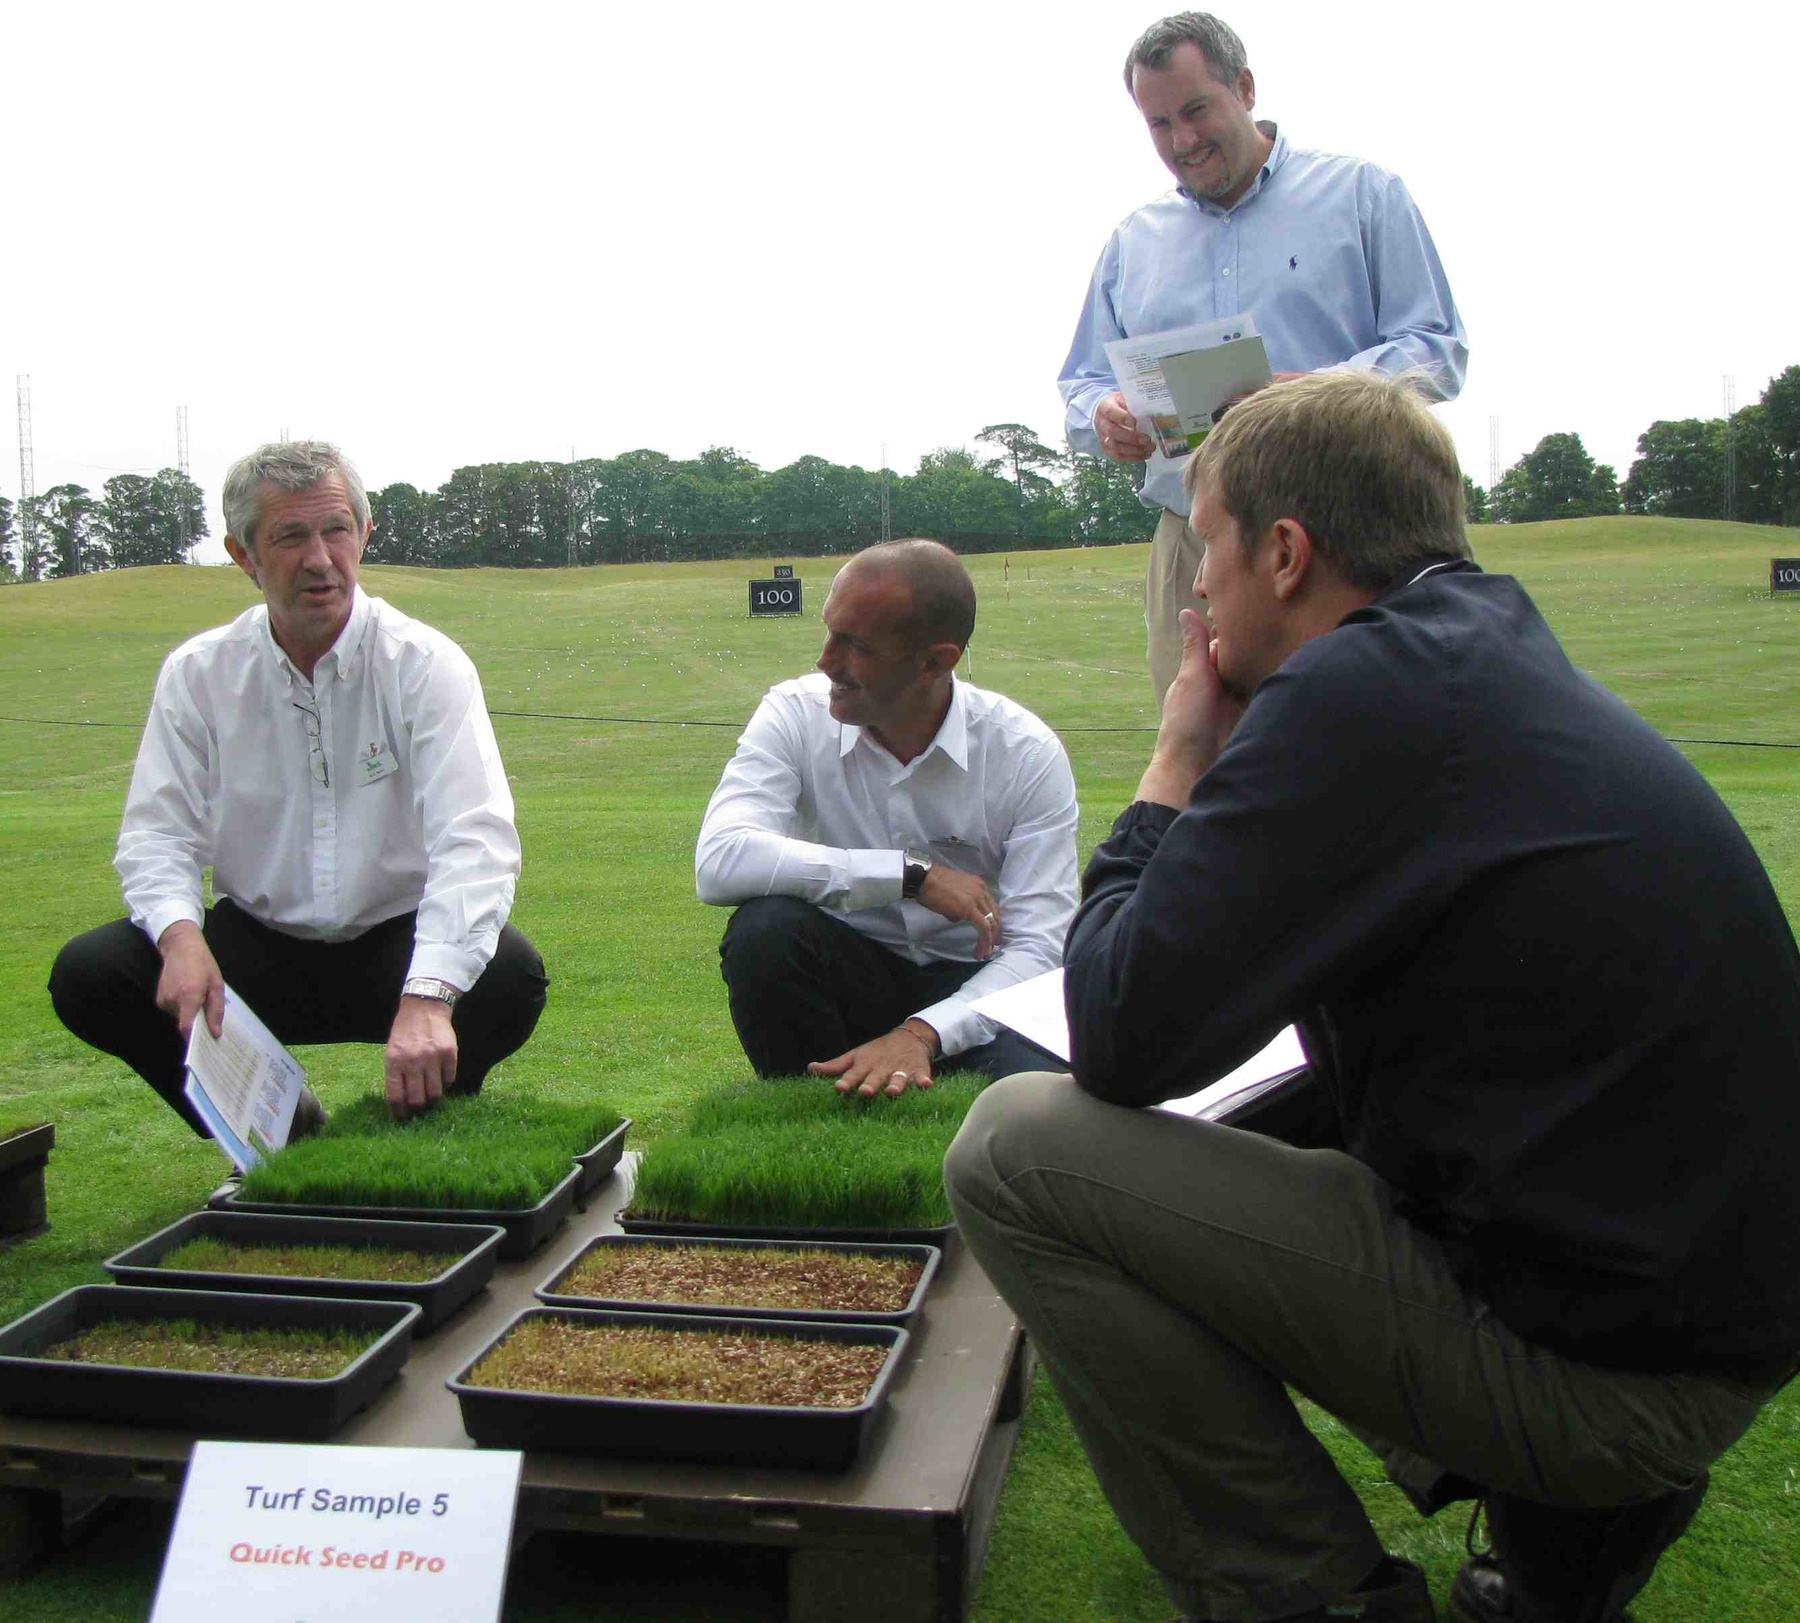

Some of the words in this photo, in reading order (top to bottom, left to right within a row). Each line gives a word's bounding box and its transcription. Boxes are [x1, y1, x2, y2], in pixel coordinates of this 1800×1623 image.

[758, 589, 793, 605] 100
[245, 1485, 305, 1511] Turf
[311, 1488, 422, 1520] Sample
[431, 1492, 450, 1517] 5
[228, 1541, 312, 1566] Quick
[321, 1546, 390, 1570] Seed
[395, 1550, 446, 1574] Pro
